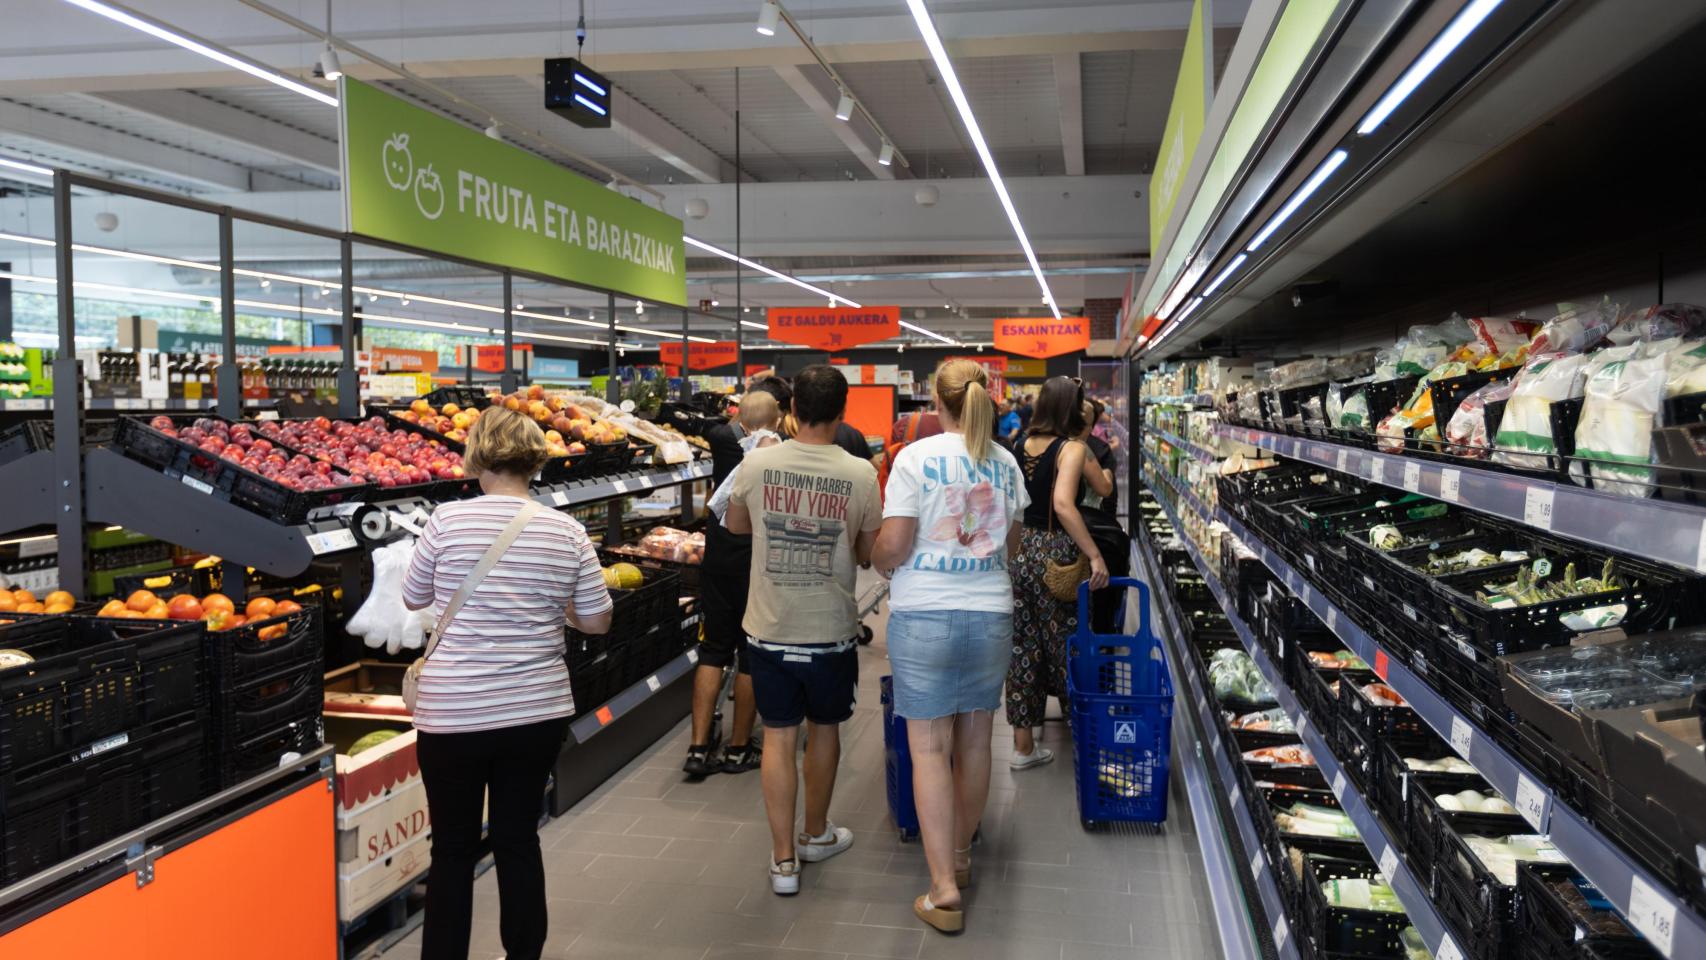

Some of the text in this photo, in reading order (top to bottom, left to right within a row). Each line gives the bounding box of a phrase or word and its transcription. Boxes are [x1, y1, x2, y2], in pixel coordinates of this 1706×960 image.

[457, 169, 675, 275] FRUTA ETA BARAZKIAK
[777, 313, 889, 327] EZ GALDU AUKERA
[1001, 324, 1083, 336] ESKAINTZAK
[763, 469, 853, 496] OLD TOWN BARBER
[763, 485, 850, 520] NEW YORK
[1652, 911, 1670, 937] 1.85
